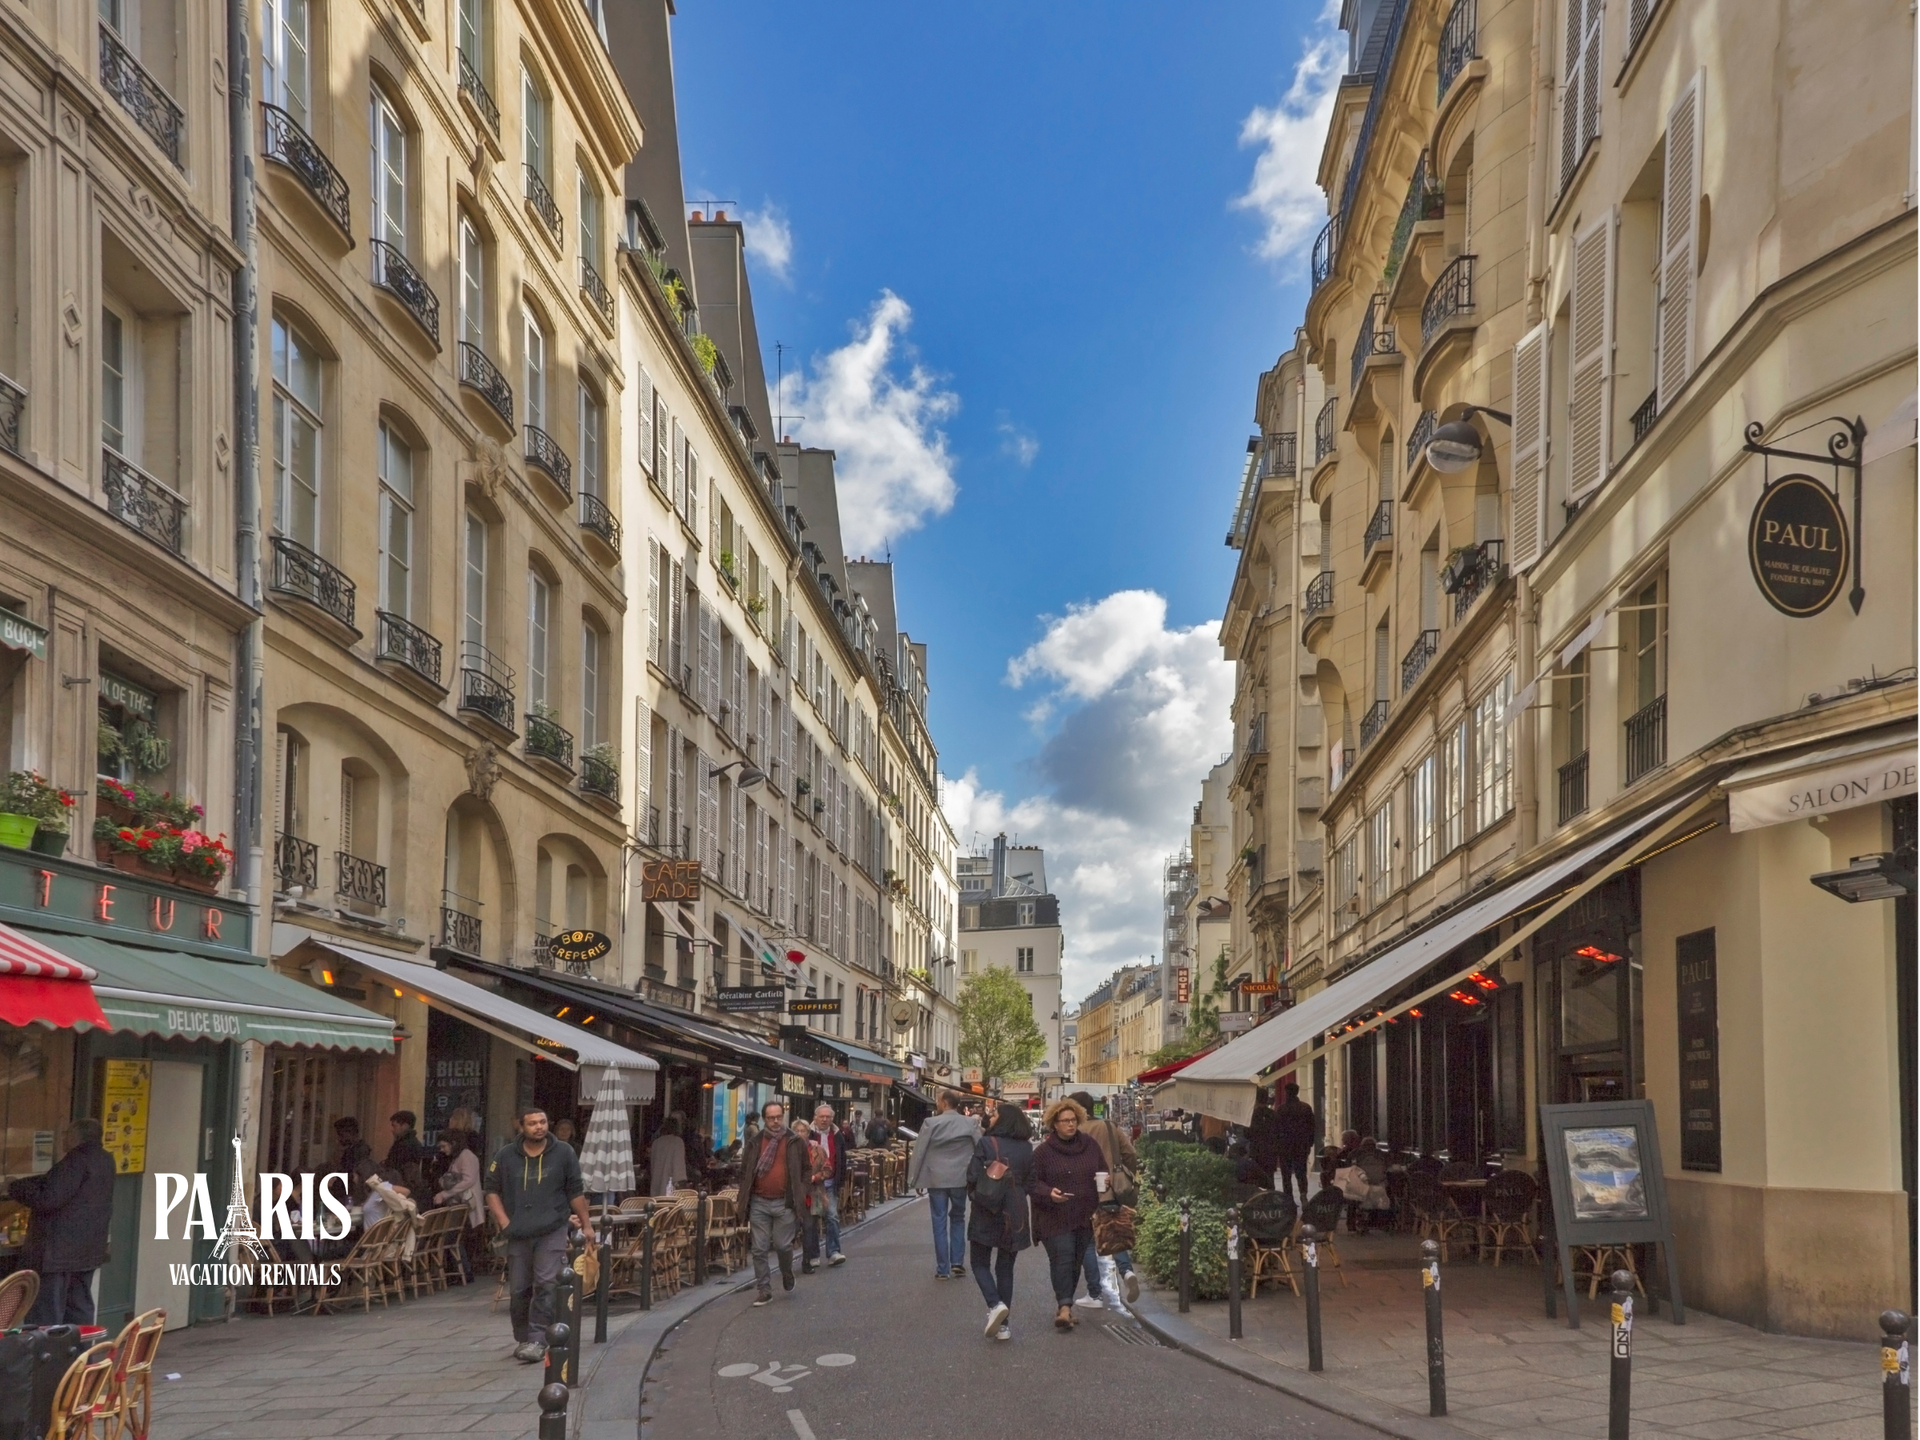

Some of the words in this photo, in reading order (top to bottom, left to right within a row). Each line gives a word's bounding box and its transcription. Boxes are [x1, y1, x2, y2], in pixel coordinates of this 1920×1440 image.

[1763, 519, 1837, 552] PAUL
[1792, 564, 1801, 572] DE
[1800, 576, 1811, 585] EN
[4, 618, 37, 650] BUCI
[112, 682, 126, 704] DE
[1788, 776, 1870, 813] SALON
[1881, 764, 1917, 792] DE
[643, 862, 699, 881] CAFE
[645, 882, 698, 899] JADE
[40, 869, 222, 940] TEUR
[550, 942, 607, 960] CREPERIE
[1681, 960, 1712, 985] PAUL
[1179, 970, 1188, 1002] HOTEL
[790, 1003, 839, 1011] COIFFIRST
[168, 1009, 210, 1032] DELICE
[213, 1014, 240, 1035] BUCI
